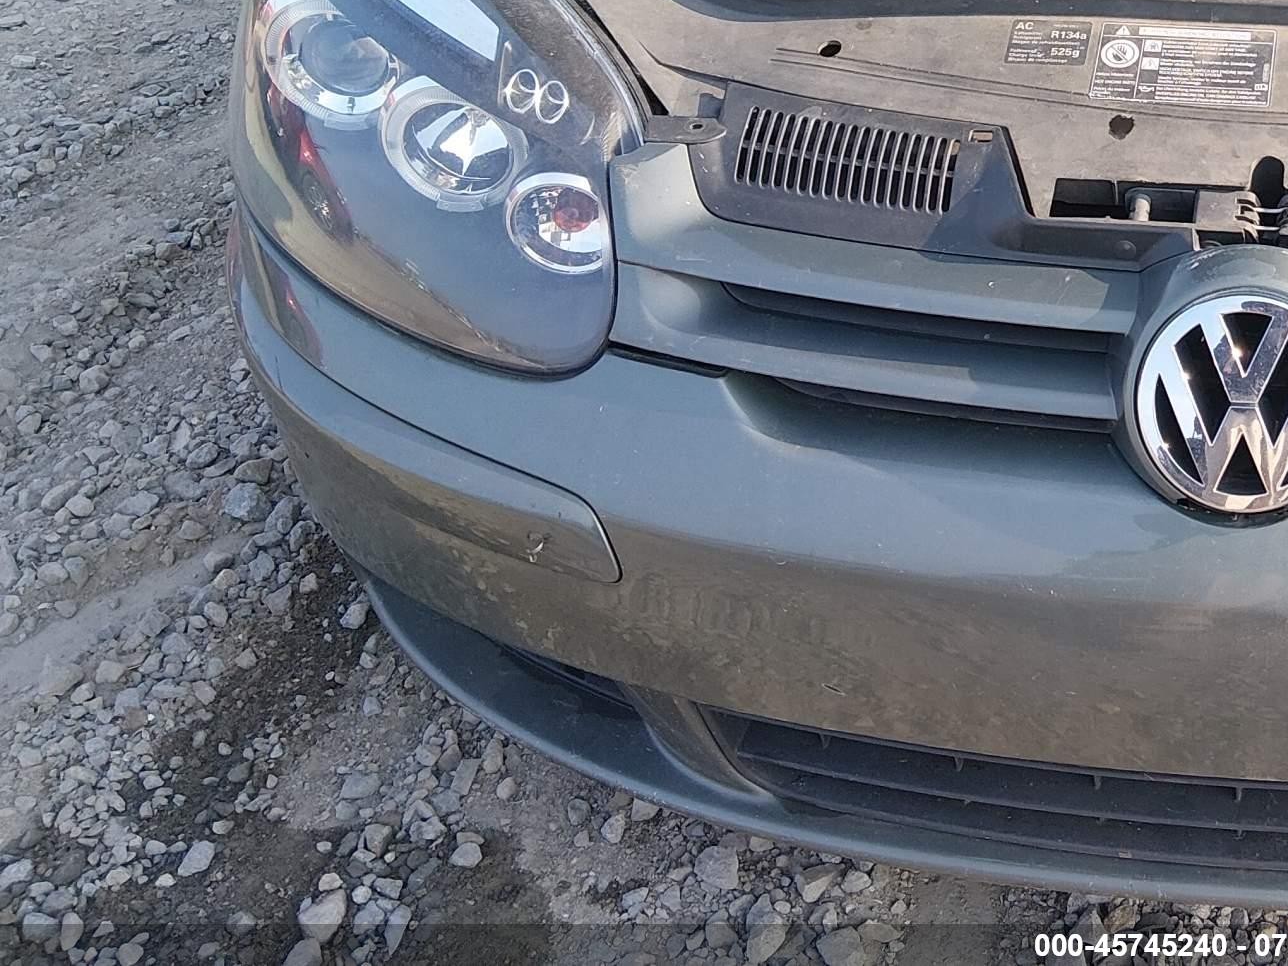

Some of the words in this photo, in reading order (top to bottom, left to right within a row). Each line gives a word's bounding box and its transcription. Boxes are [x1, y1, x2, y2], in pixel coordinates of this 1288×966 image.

[1015, 21, 1034, 30] AC
[1050, 30, 1087, 40] R134a
[1050, 47, 1080, 58] 525g
